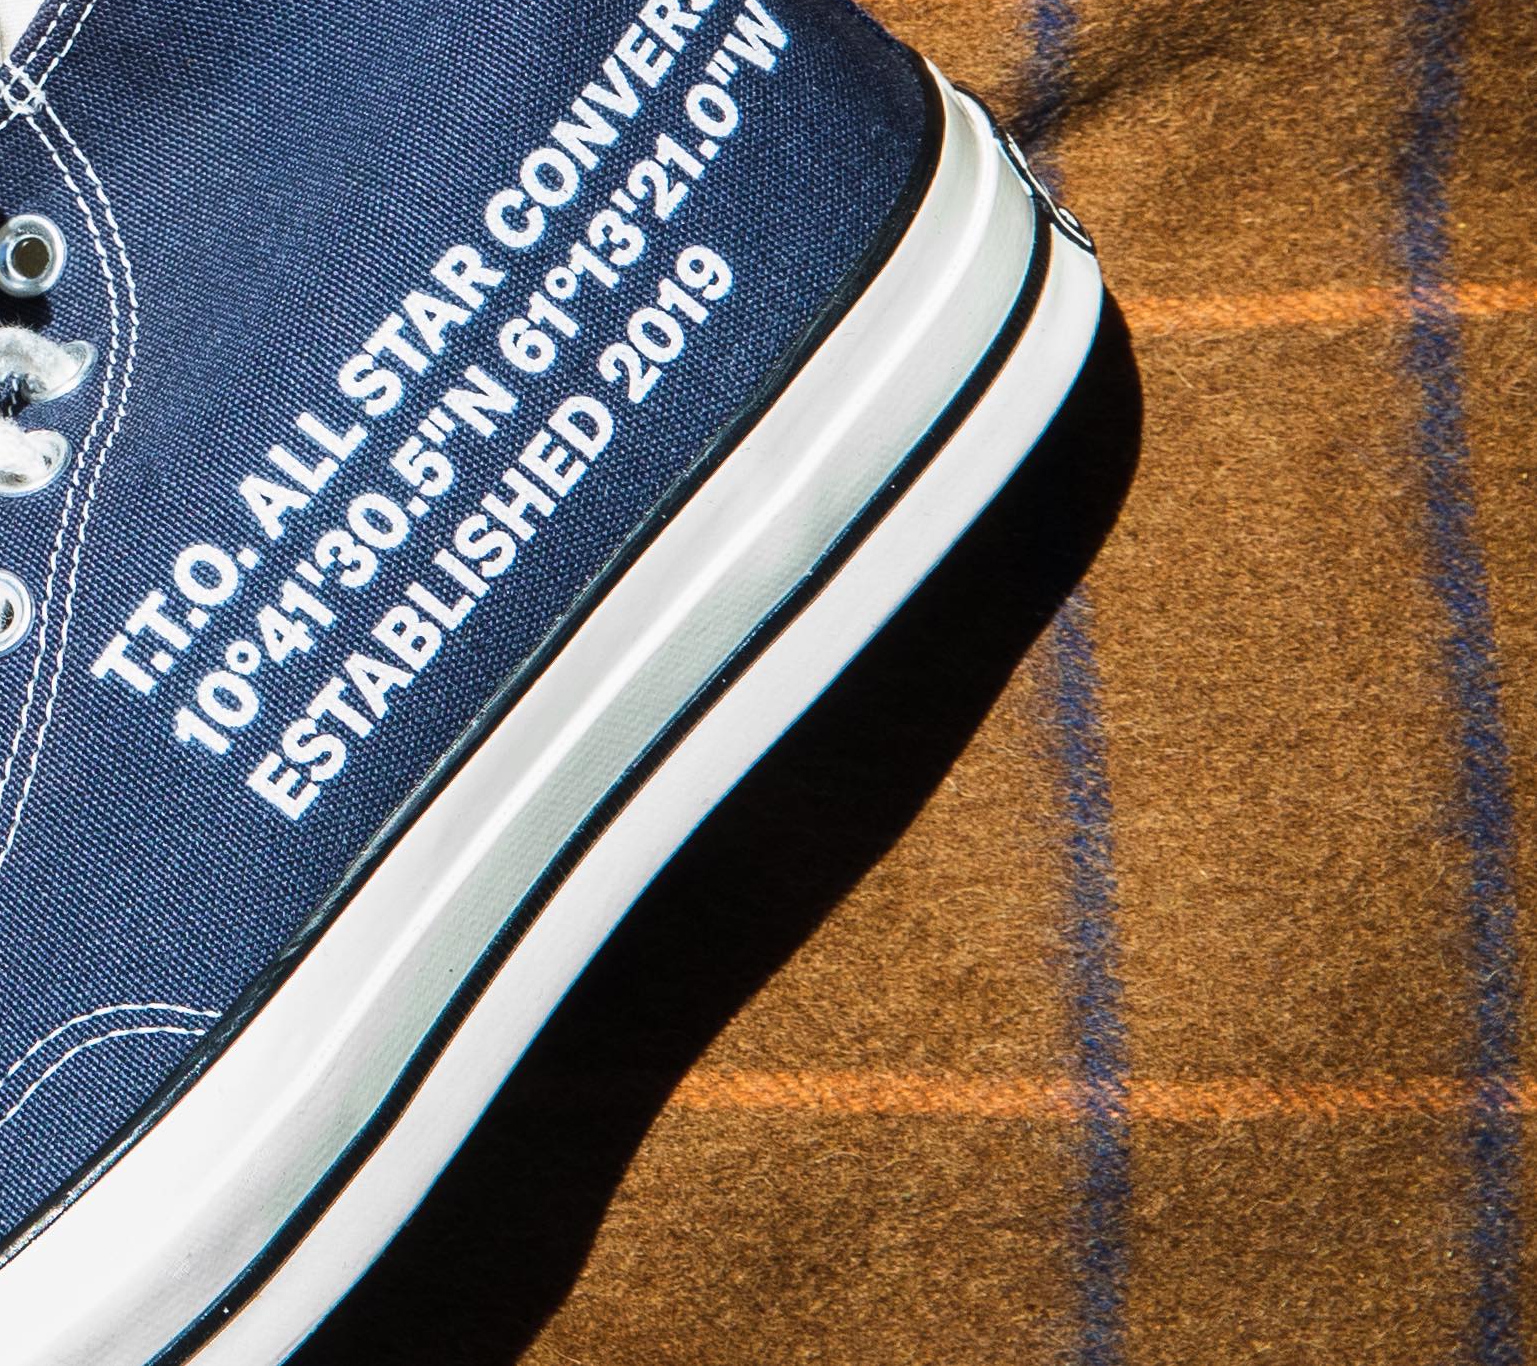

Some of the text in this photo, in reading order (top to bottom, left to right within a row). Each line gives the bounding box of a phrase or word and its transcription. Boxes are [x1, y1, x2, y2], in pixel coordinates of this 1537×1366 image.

[88, 516, 259, 707] T.T.O.
[233, 389, 368, 540] ALL
[337, 236, 505, 426] STAR
[243, 245, 732, 820] ESTABLISHED 2019
